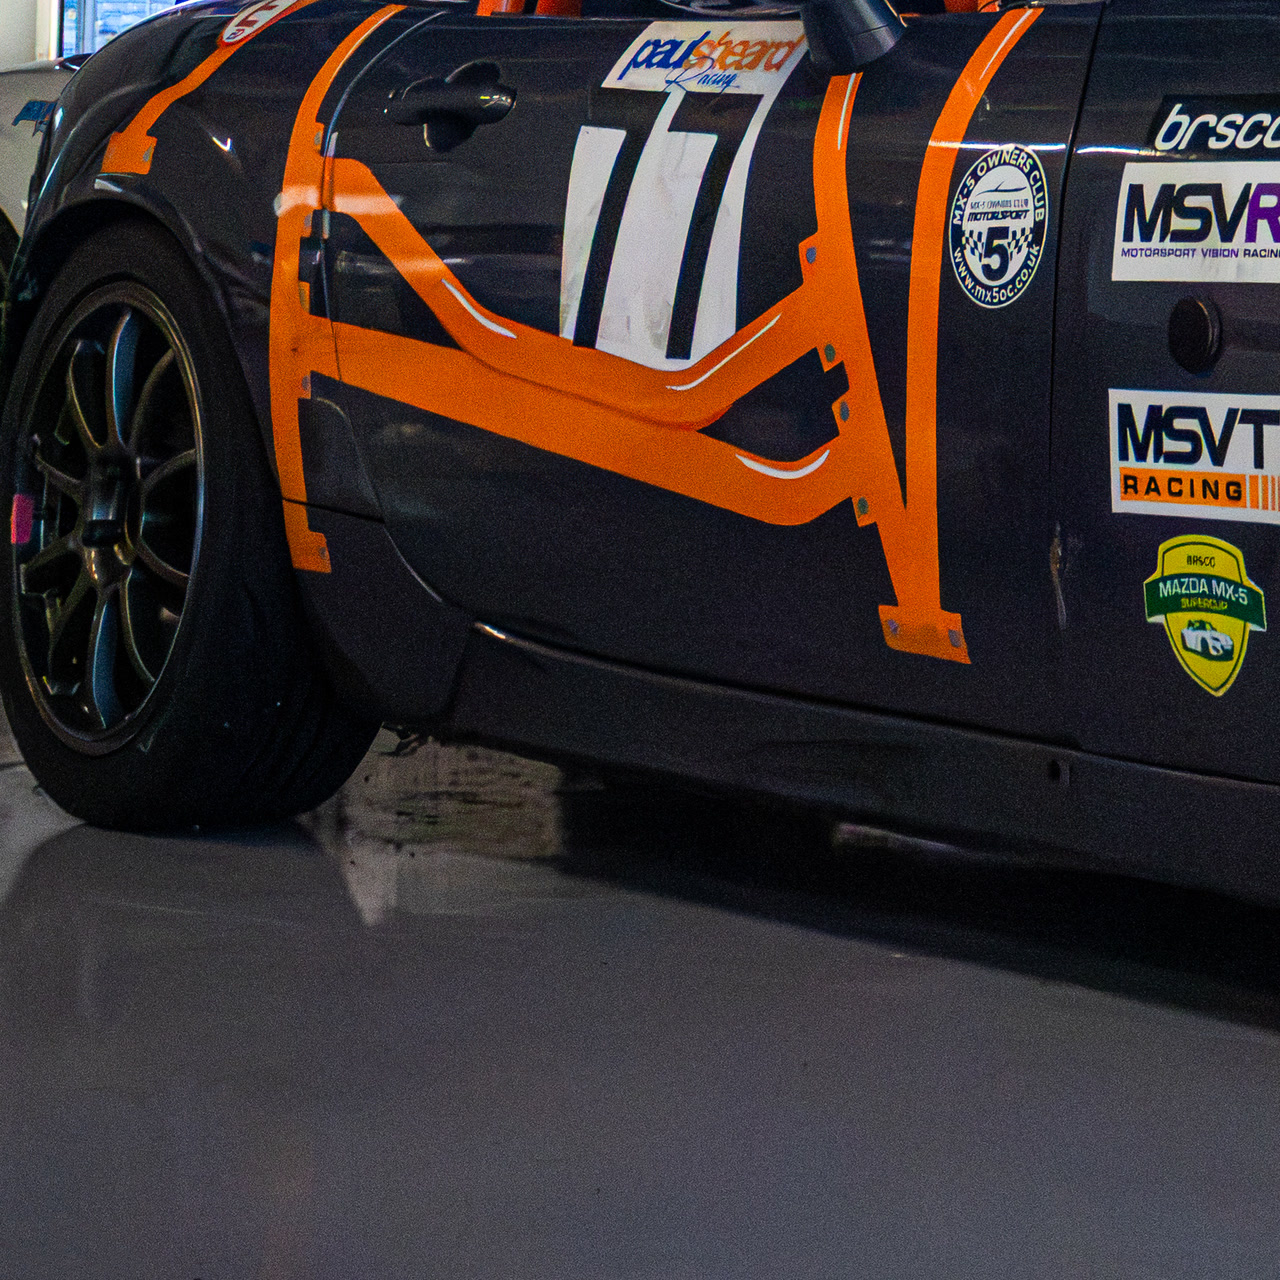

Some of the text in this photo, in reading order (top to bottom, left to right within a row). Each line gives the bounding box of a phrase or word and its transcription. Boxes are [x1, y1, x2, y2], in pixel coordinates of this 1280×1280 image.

[665, 56, 740, 94] Racing
[953, 147, 1046, 225] MX-5 OWNERS CLUB
[573, 88, 764, 360] 77
[968, 209, 1030, 222] MOTORSPORT
[953, 243, 1040, 304] www.mx5oc.co.uk
[981, 226, 1009, 281] 5
[1121, 247, 1196, 258] MOTORSPORT
[1201, 248, 1239, 258] VISION
[1118, 403, 1280, 470] MSVT
[1123, 475, 1242, 502] RACING
[1158, 577, 1248, 605] MAZDA MX-5
